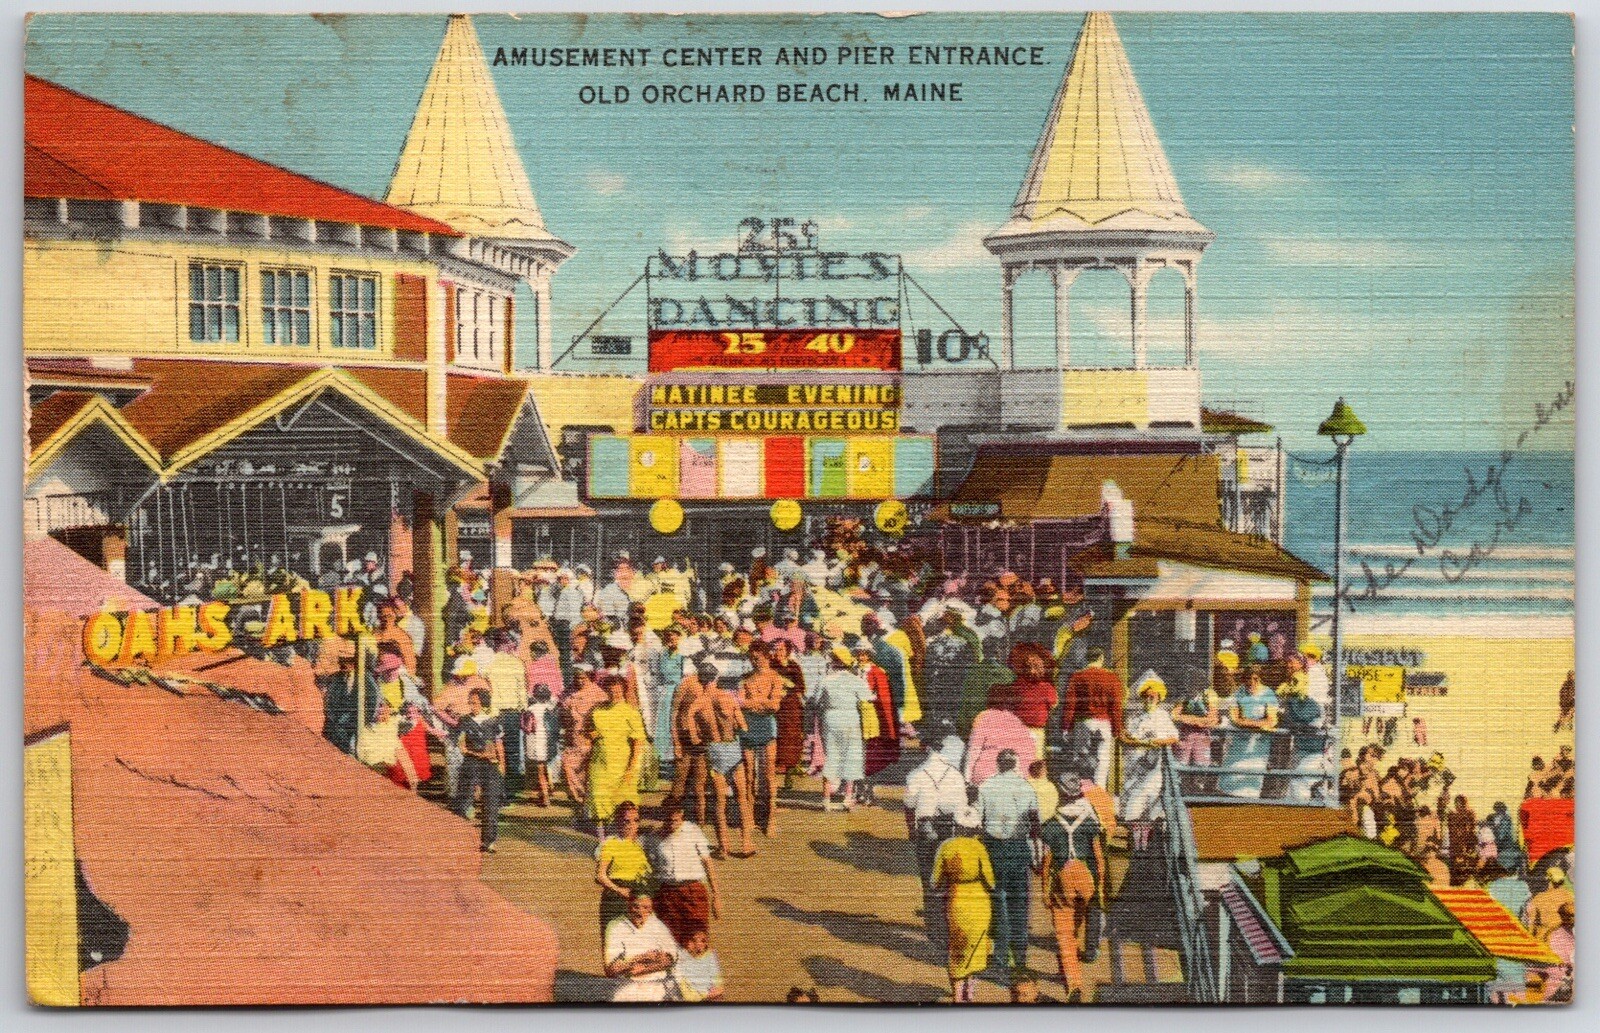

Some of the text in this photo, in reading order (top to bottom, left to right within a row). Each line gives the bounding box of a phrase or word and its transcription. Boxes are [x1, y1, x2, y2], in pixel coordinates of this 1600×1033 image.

[658, 248, 893, 282] MOVIES
[652, 294, 899, 327] DANCING
[721, 332, 856, 354] 25 40
[651, 384, 895, 404] MATINEE EVENING
[650, 410, 897, 430] CAPTS COURAGEOUS
[262, 587, 370, 648] ARK
